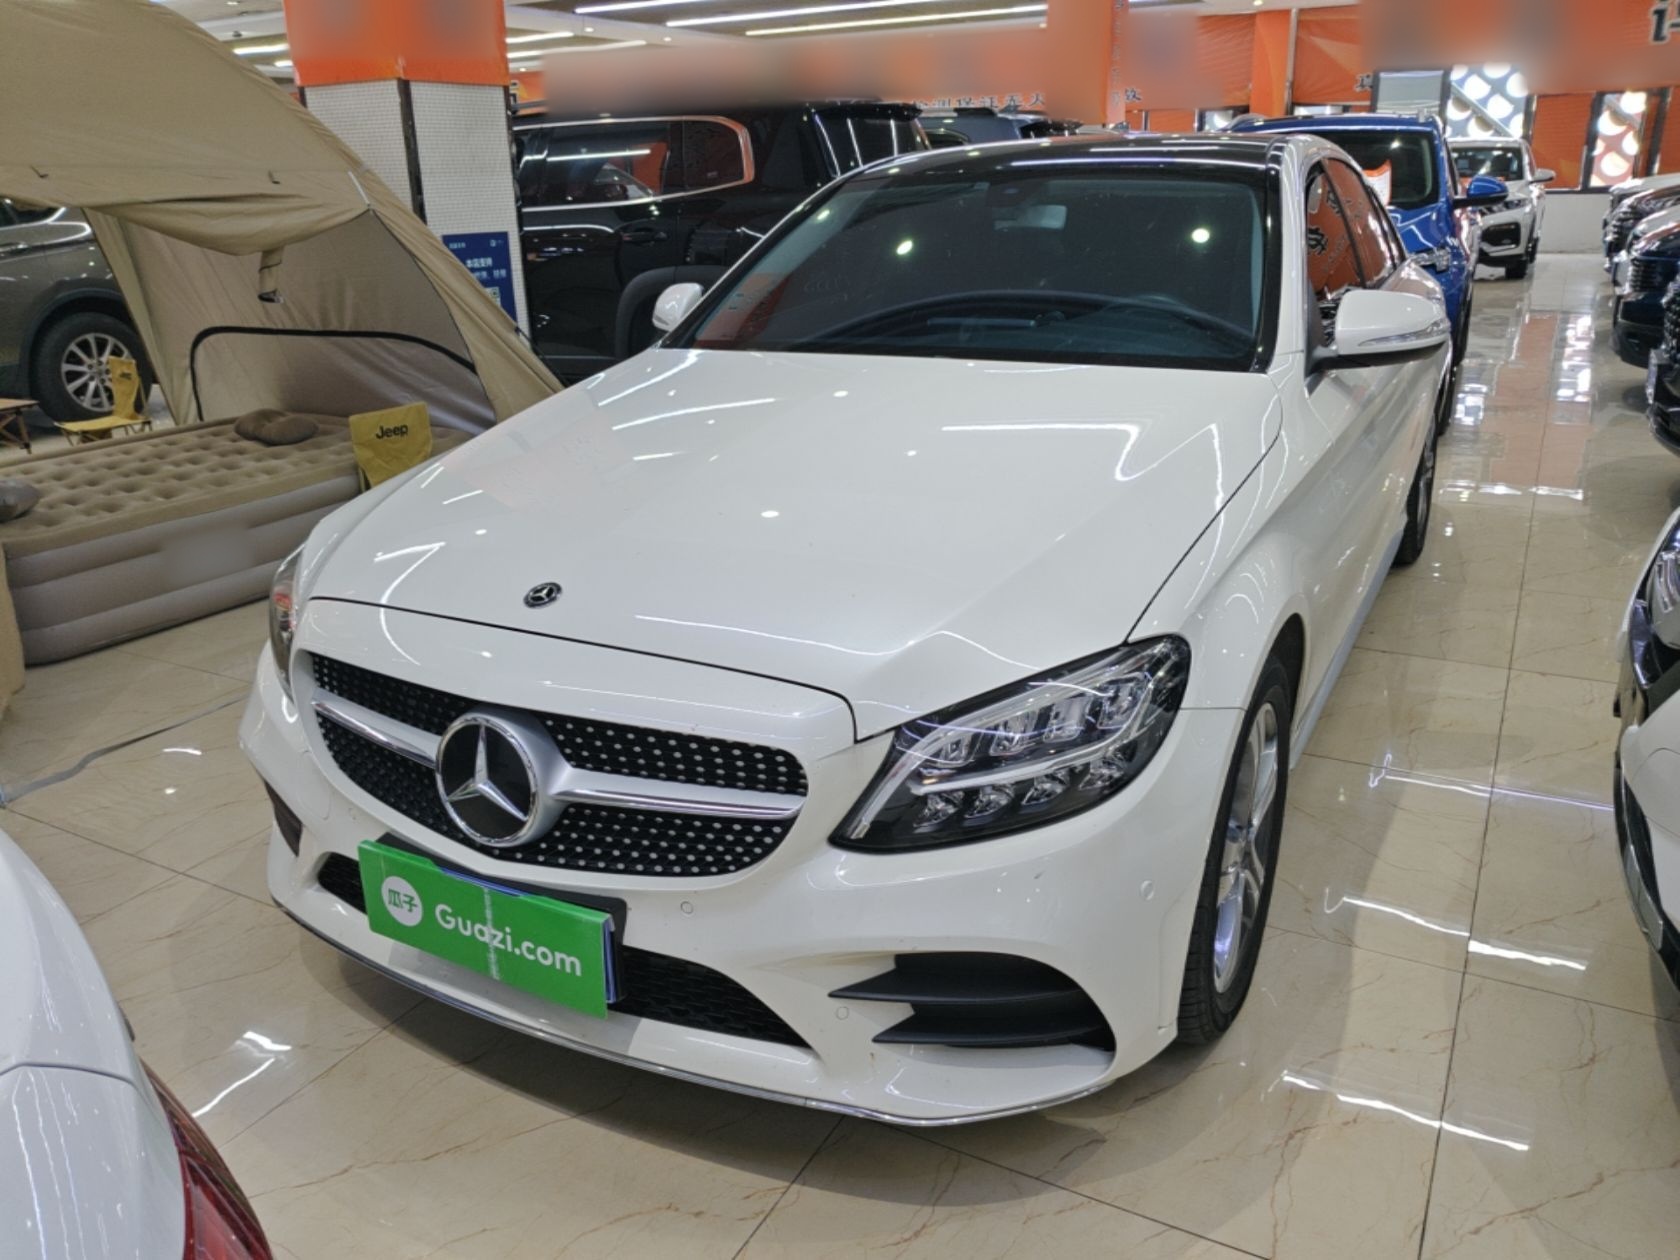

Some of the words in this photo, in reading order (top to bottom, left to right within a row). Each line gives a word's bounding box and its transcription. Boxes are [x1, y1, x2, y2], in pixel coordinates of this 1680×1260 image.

[375, 424, 409, 440] Jeep
[388, 888, 418, 913] 瓜子
[434, 903, 582, 977] Guazi.com
